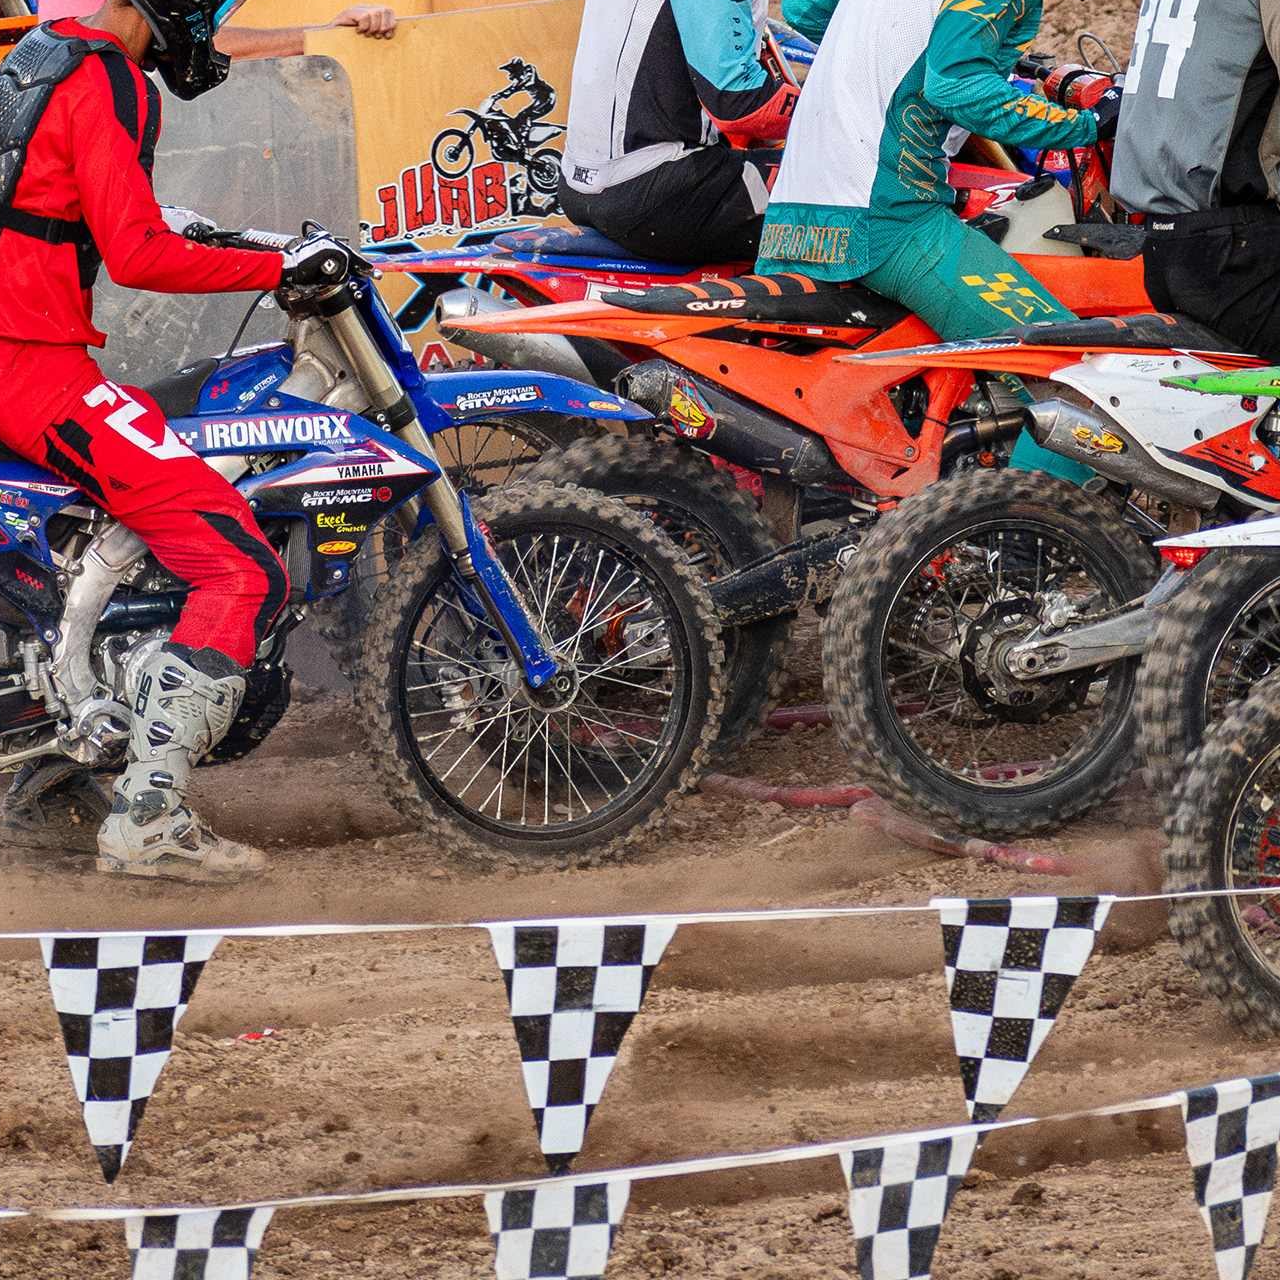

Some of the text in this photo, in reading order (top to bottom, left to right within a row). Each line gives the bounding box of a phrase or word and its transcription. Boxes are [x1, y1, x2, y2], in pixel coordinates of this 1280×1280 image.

[686, 298, 746, 312] GUTS
[779, 325, 798, 333] READY
[798, 326, 807, 334] TO
[467, 384, 535, 400] ROCKY MOUNTAIN
[1242, 398, 1256, 411] 66
[206, 414, 352, 449] IRONWORX
[313, 438, 356, 446] EXCAVAT
[337, 464, 384, 479] YAMAHA
[28, 483, 68, 495] DELTAFIT
[313, 487, 373, 498] ROCKY MOUNTAIN
